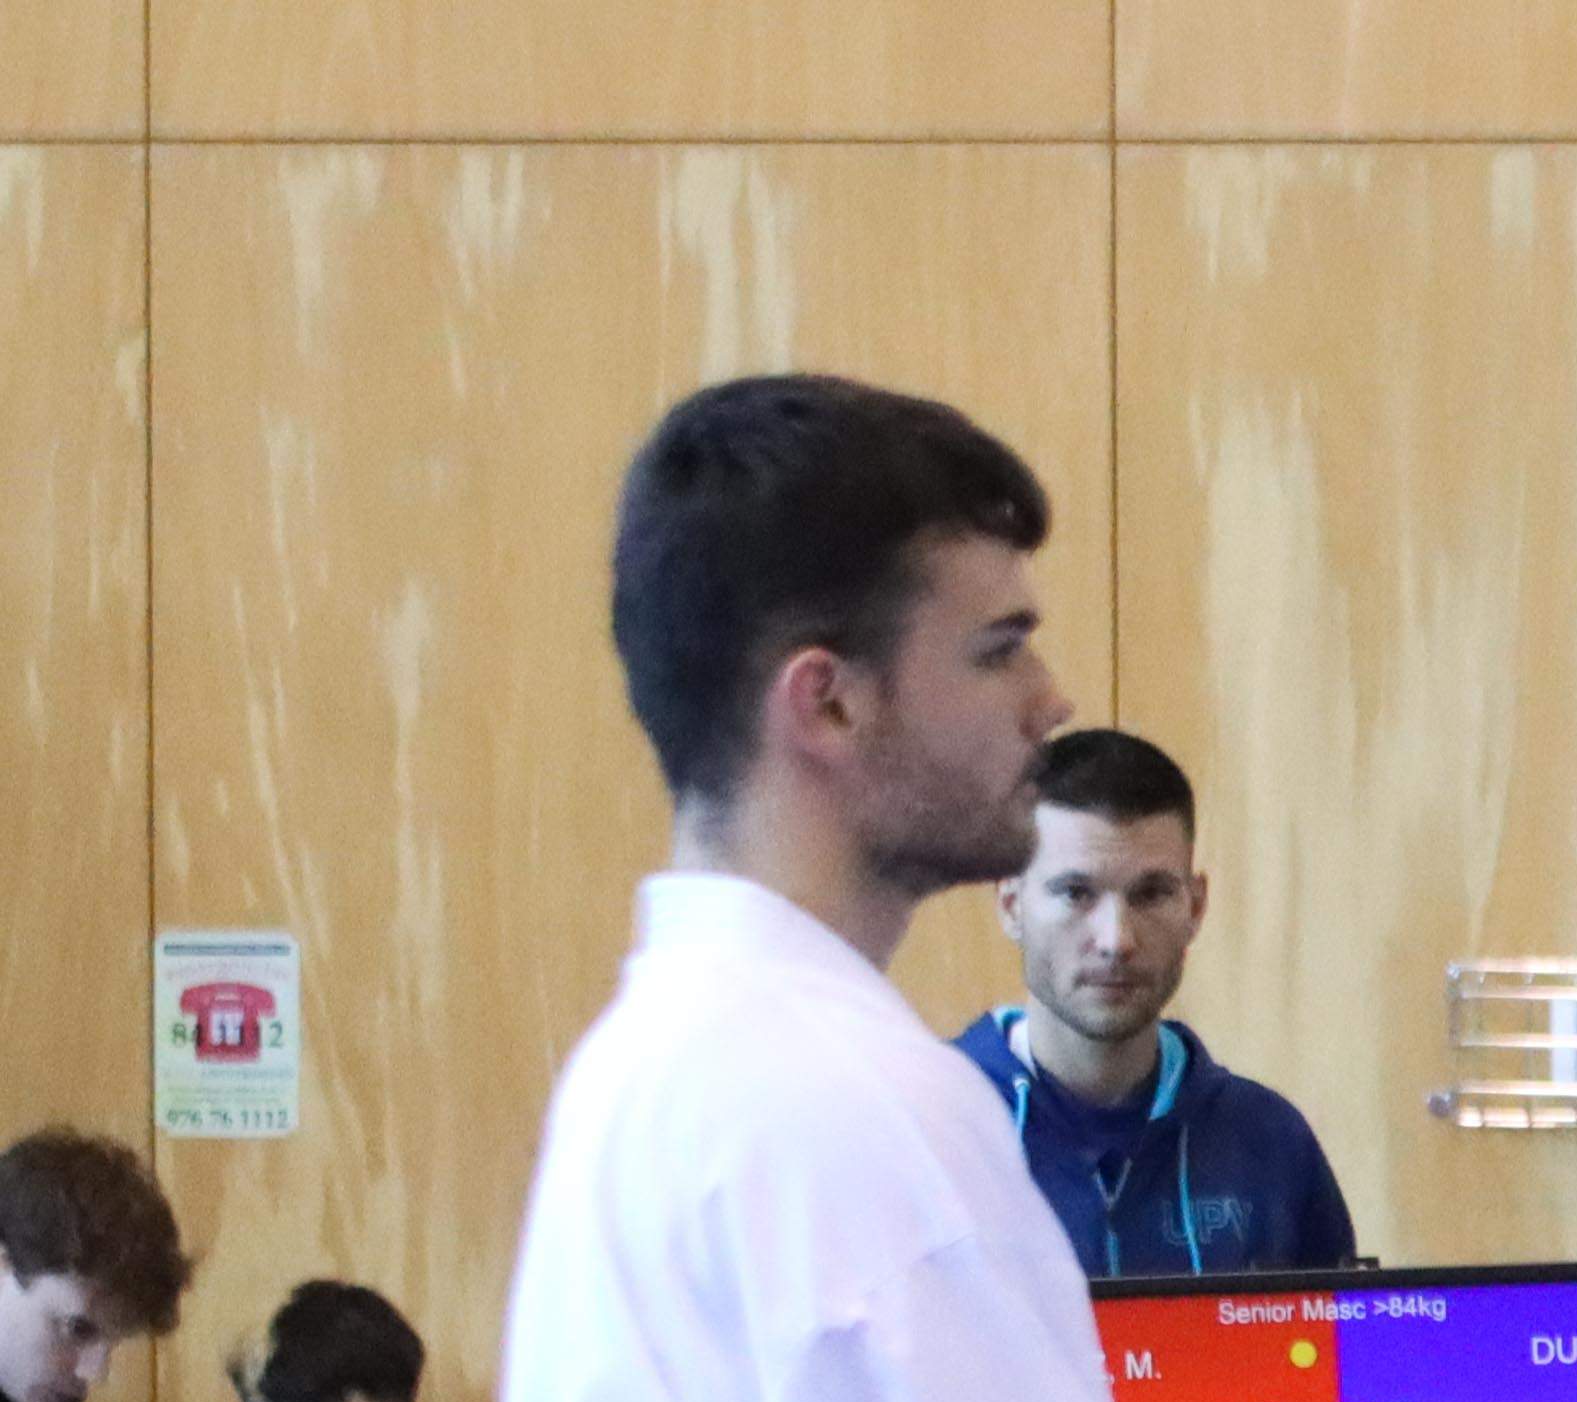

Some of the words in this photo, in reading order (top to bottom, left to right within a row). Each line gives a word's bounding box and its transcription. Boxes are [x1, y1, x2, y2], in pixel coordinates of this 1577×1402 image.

[1217, 1298, 1295, 1325] Senior
[1303, 1295, 1366, 1322] Masc
[1373, 1295, 1447, 1322] >84kg
[1125, 1350, 1163, 1381] M.
